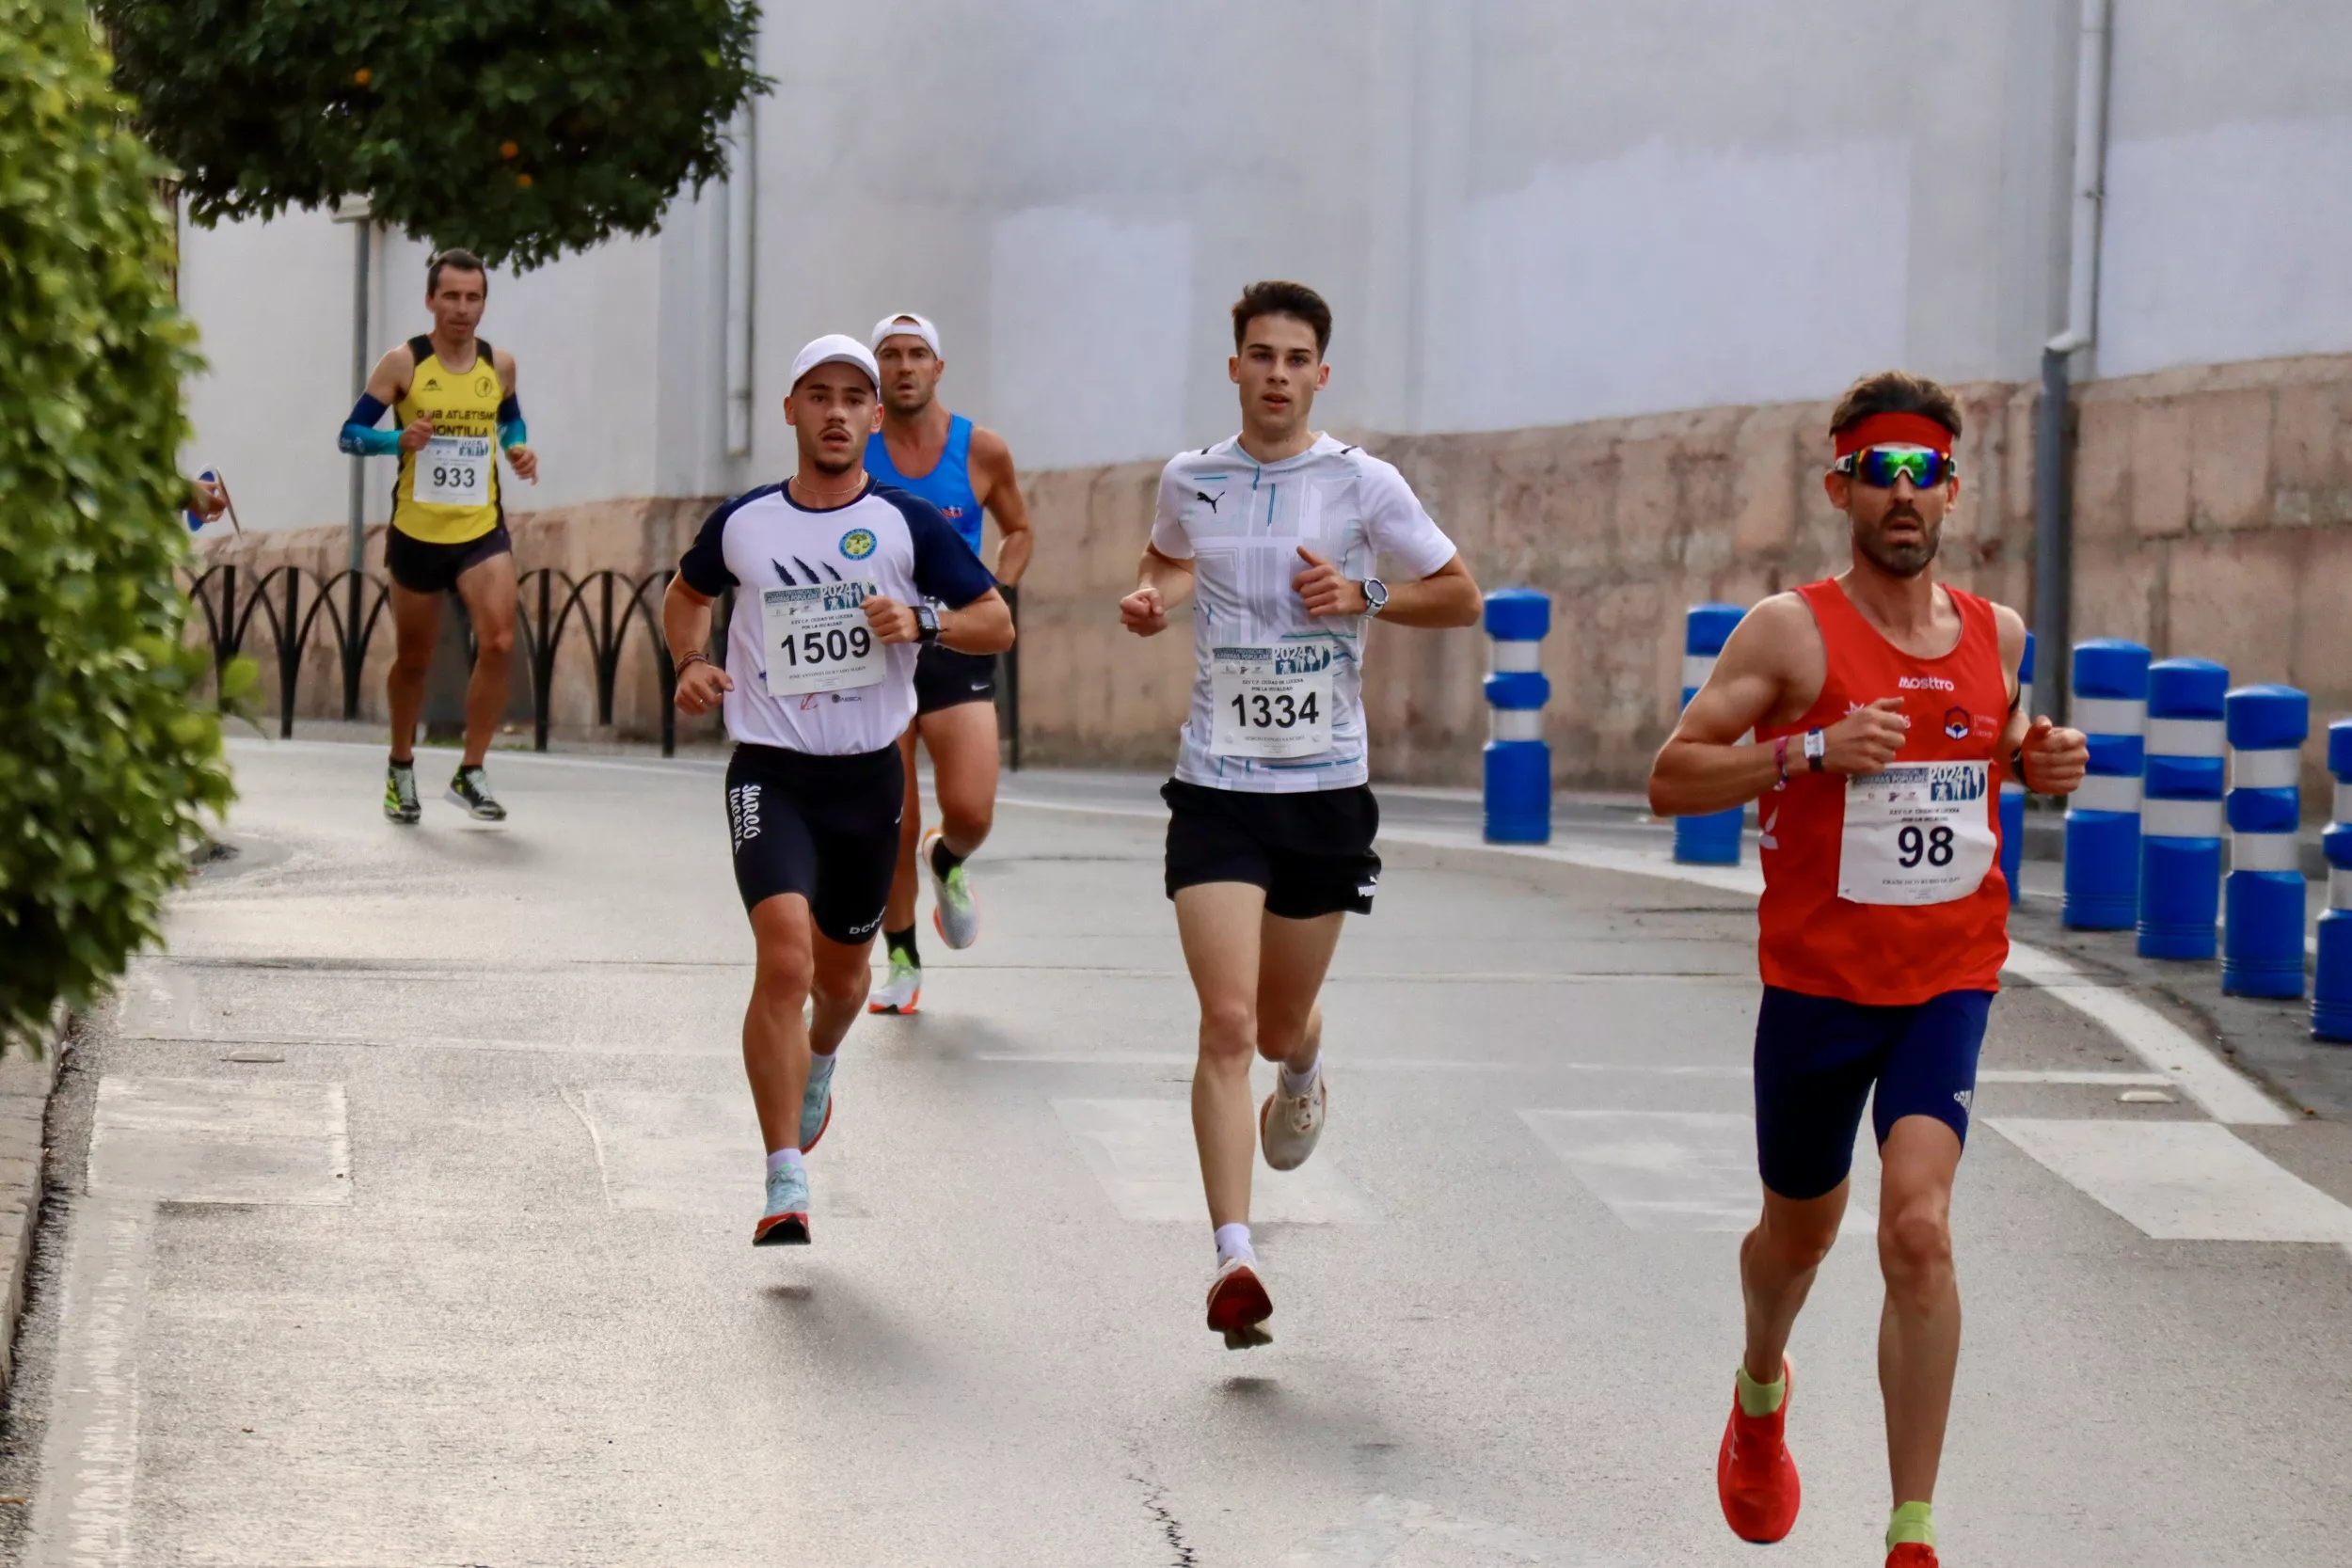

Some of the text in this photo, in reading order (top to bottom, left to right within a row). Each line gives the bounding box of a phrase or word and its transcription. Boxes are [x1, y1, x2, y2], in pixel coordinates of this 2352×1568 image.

[433, 467, 475, 488] 933
[821, 583, 853, 598] 2024
[781, 626, 870, 667] 1509
[1274, 646, 1306, 660] 2024
[1231, 691, 1319, 729] 1334
[1930, 766, 1964, 783] 2024
[1898, 825, 1954, 868] 98
